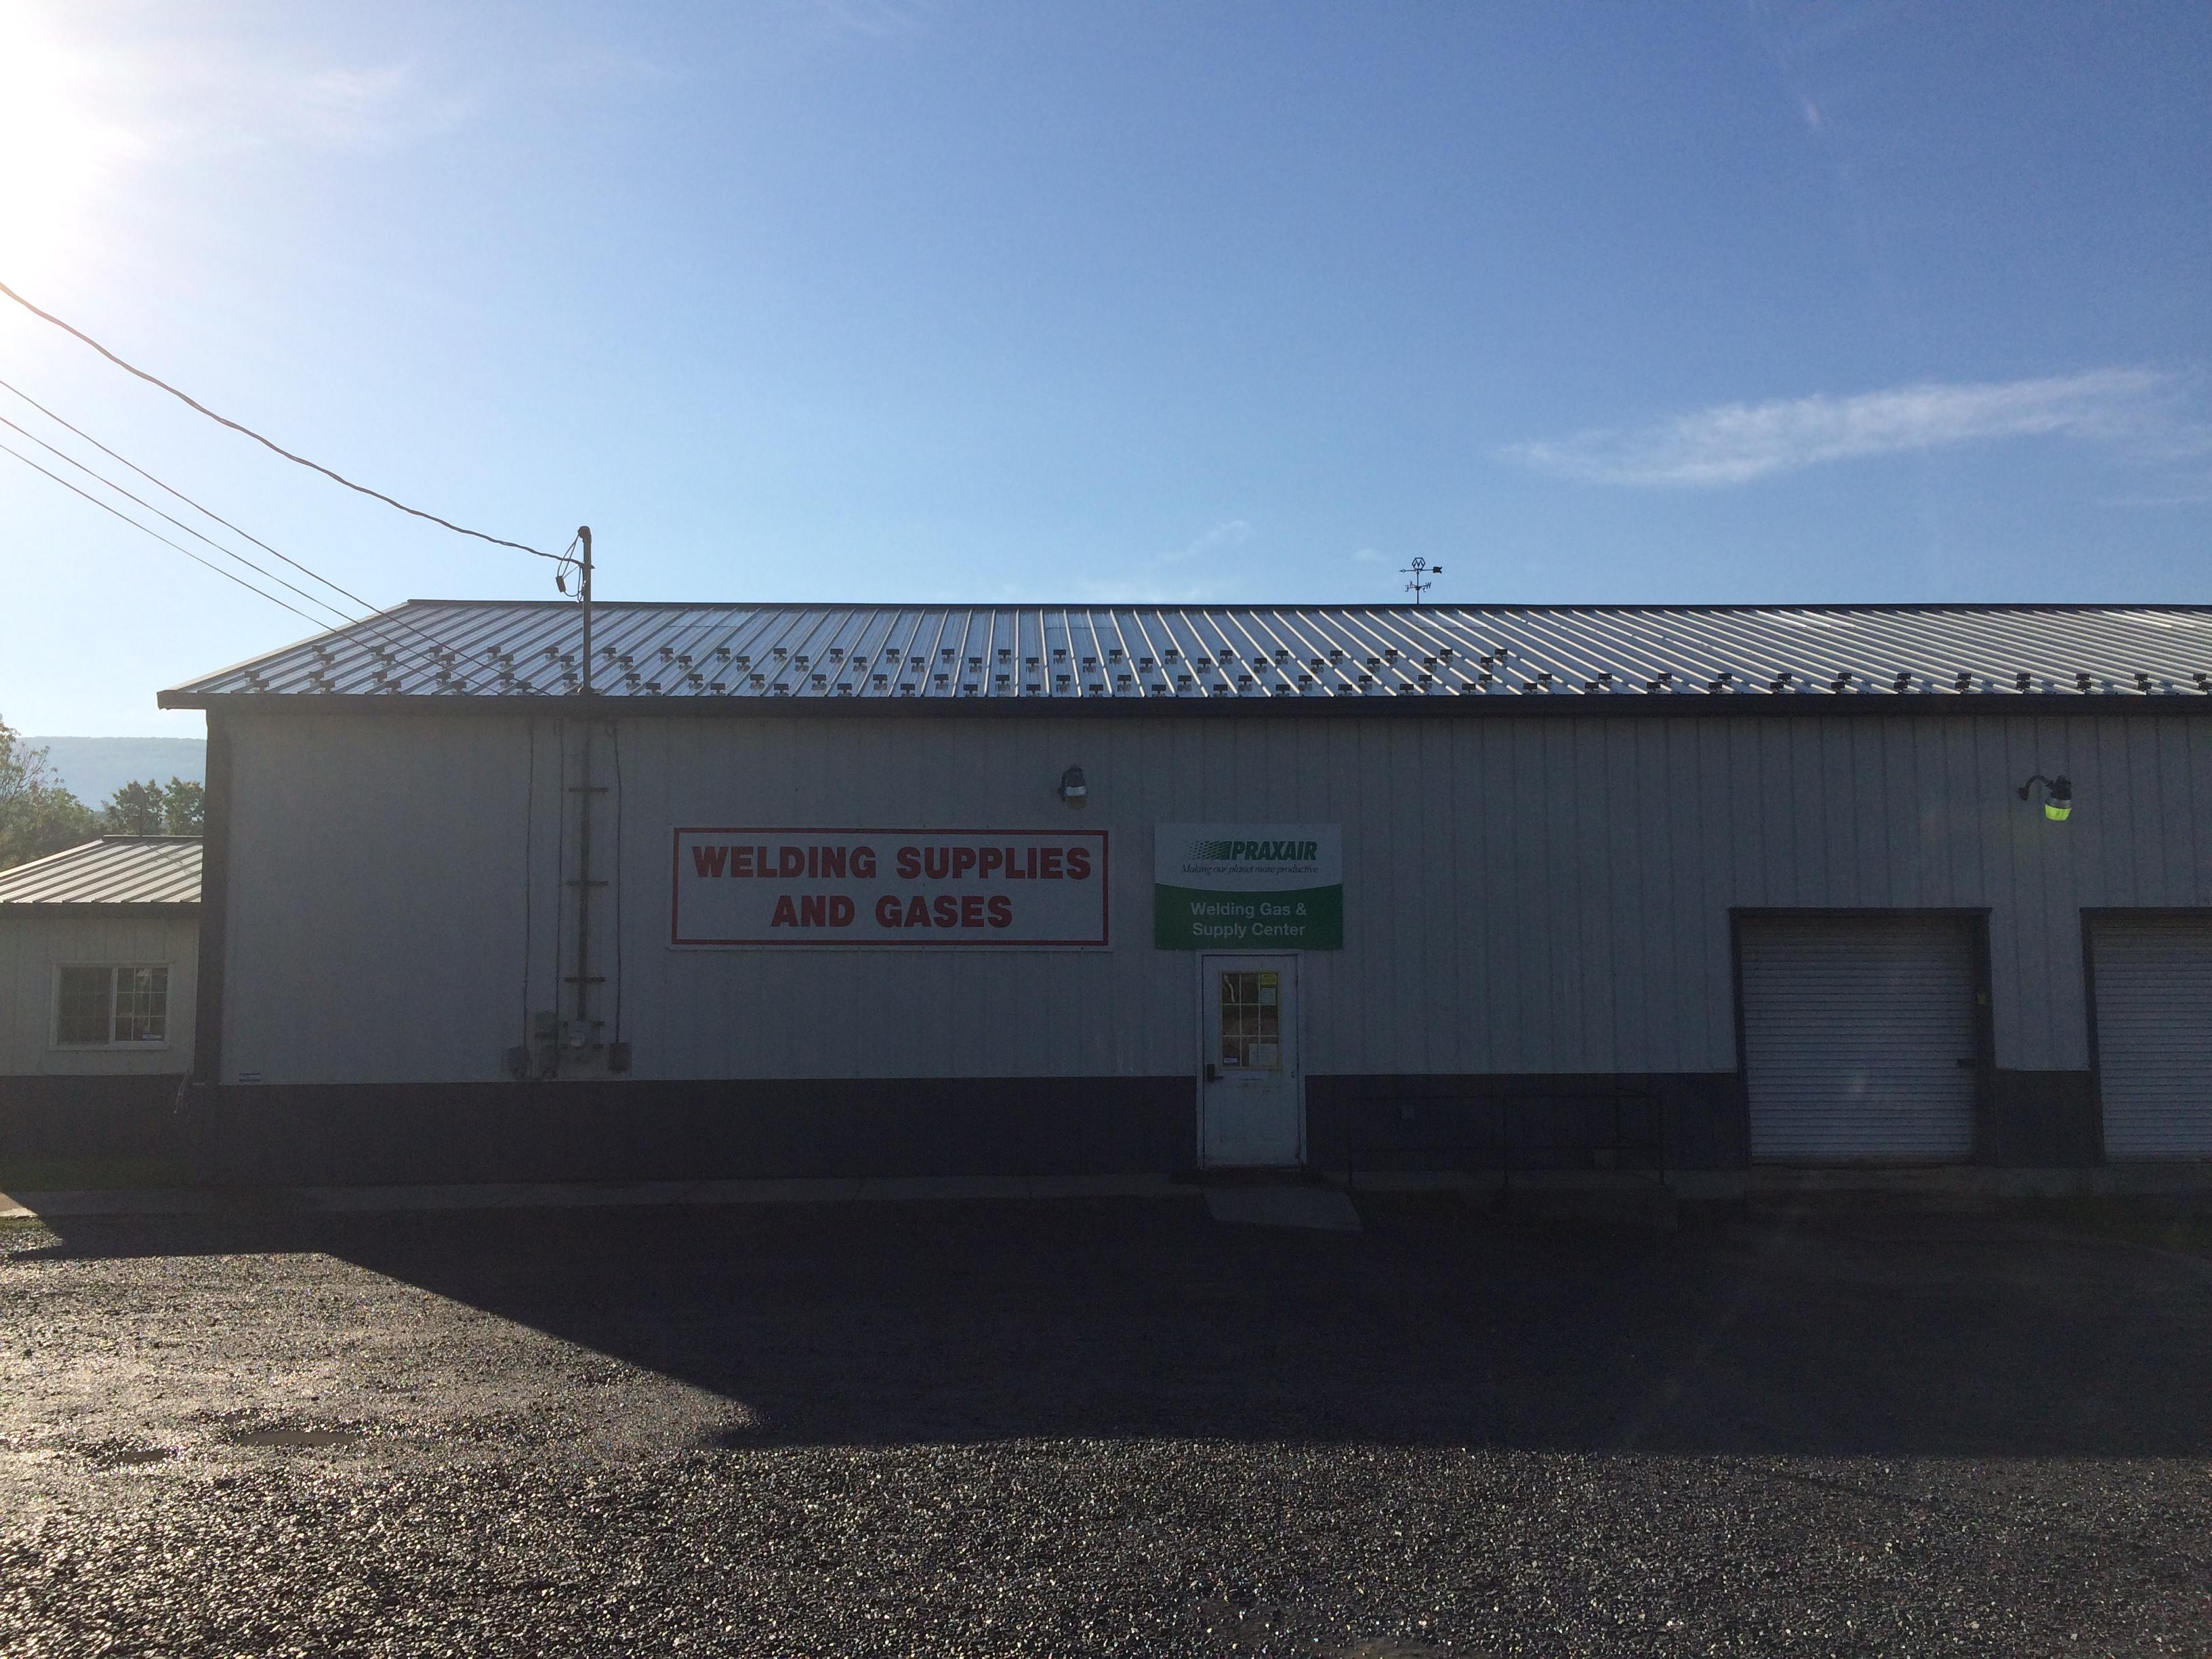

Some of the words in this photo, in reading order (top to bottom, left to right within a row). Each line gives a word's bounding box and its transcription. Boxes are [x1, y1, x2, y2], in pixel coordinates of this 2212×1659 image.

[1231, 840, 1317, 860] PRAXAIR
[692, 846, 876, 878] WELDING
[896, 846, 1091, 880] SUPPLIES
[1181, 864, 1211, 876] Making
[1228, 865, 1254, 874] planet
[1275, 865, 1318, 876] productive
[771, 895, 855, 928] AND
[875, 895, 1012, 928] GASES
[1190, 902, 1254, 918] Welding
[1259, 903, 1291, 916] Gas
[1295, 903, 1307, 916] &
[1193, 922, 1247, 939] Supply
[1252, 922, 1306, 936] Center
